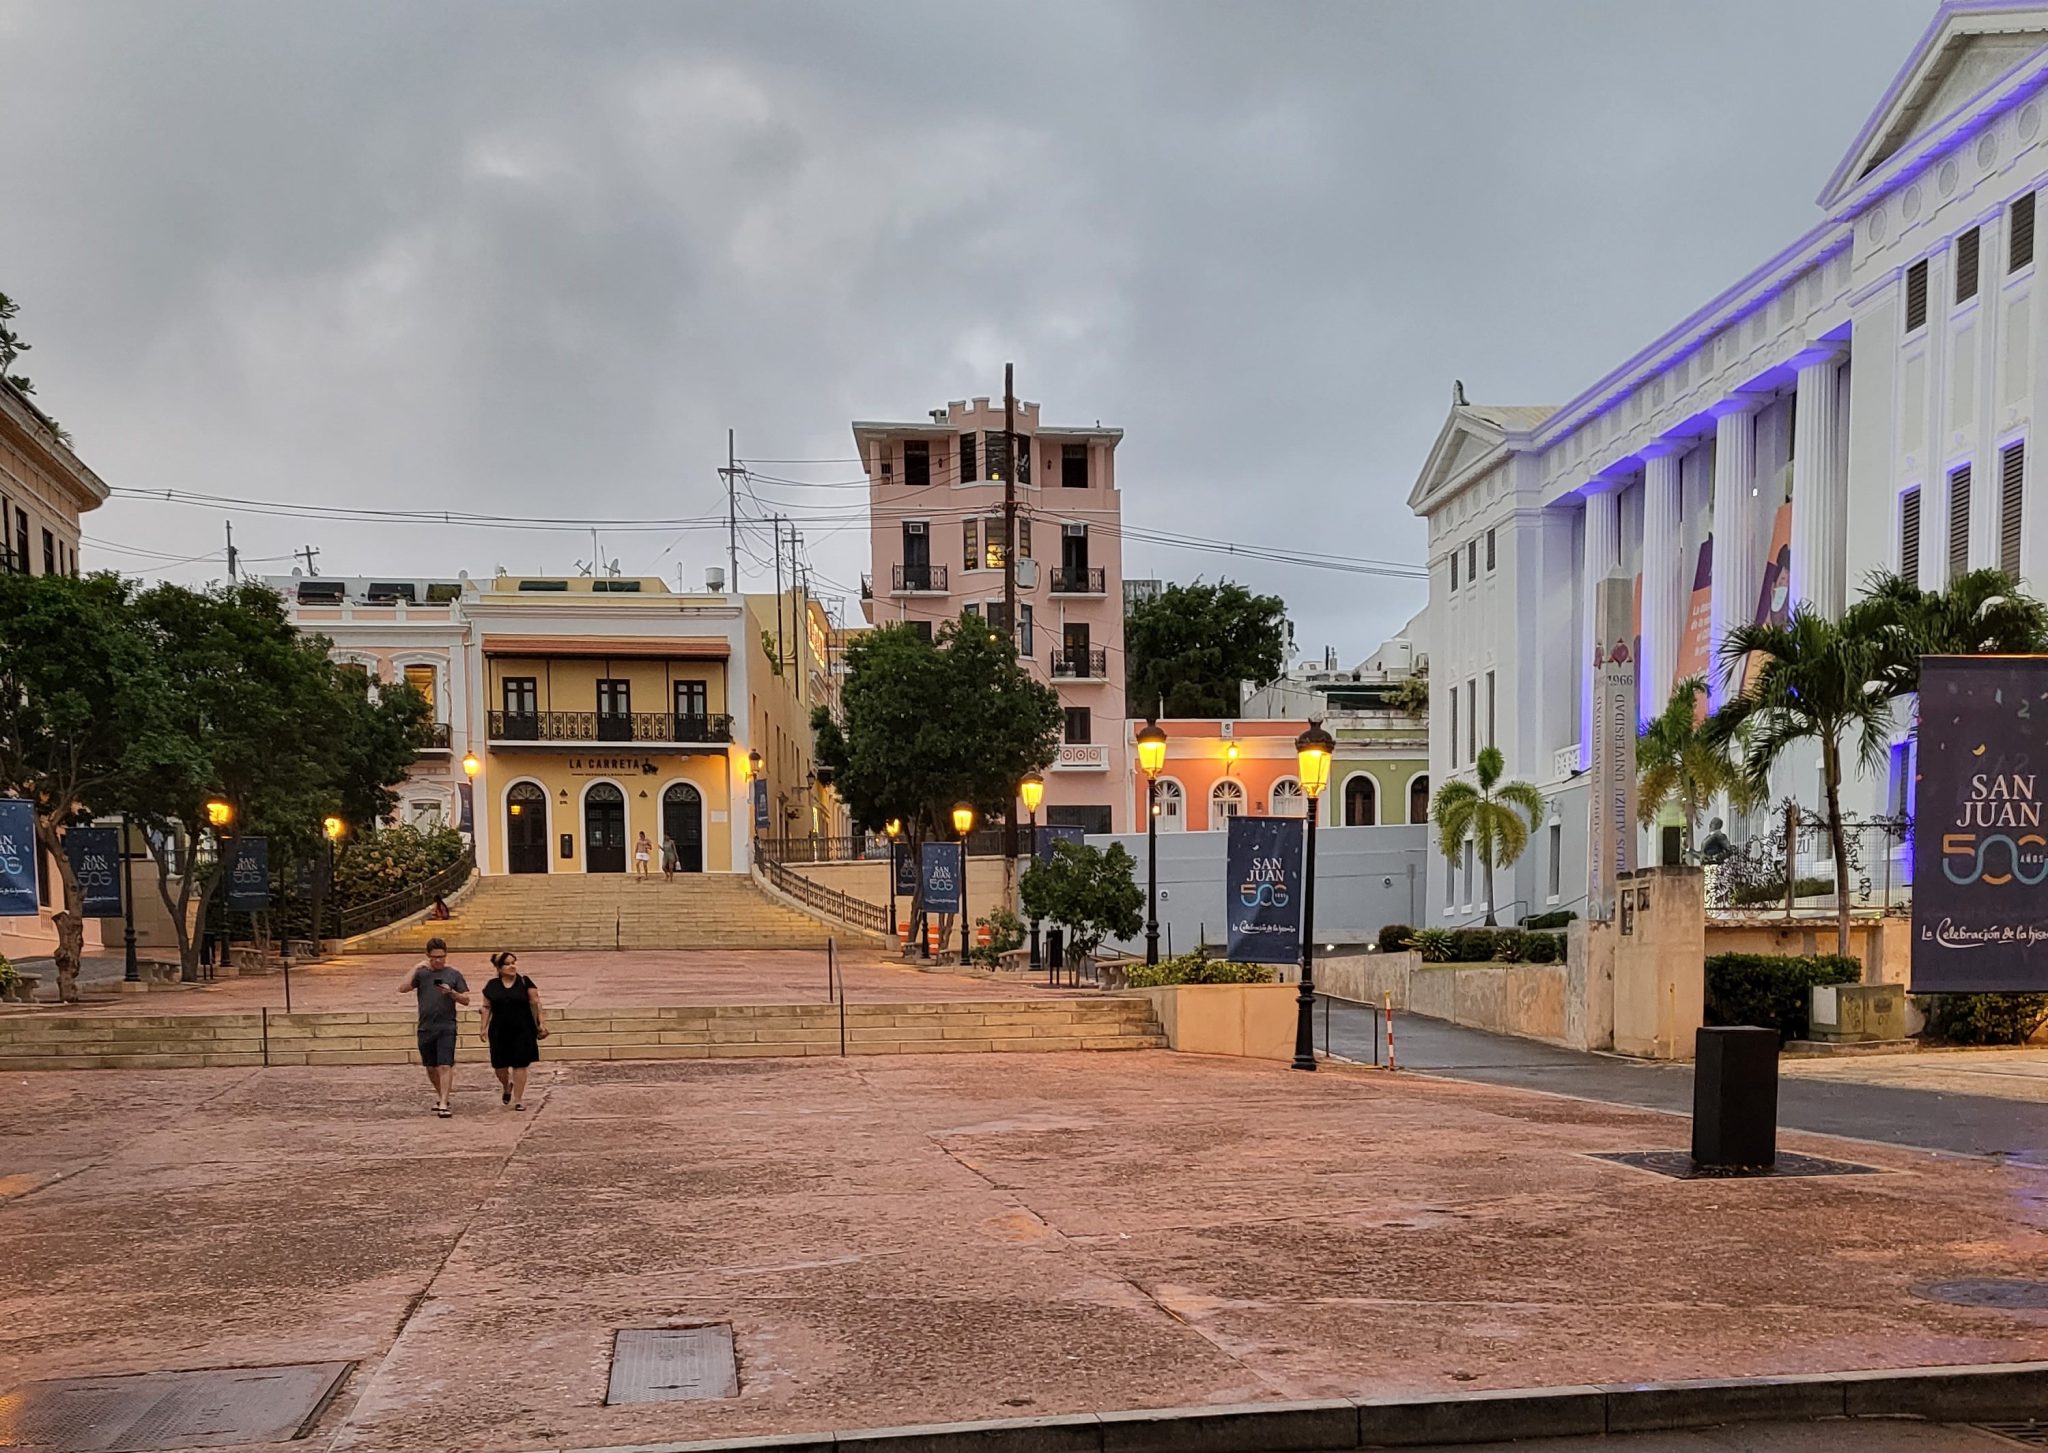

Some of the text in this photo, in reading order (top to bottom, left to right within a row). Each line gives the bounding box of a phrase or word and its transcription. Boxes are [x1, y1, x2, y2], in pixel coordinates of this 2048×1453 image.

[1607, 674, 1633, 686] 1966
[569, 759, 640, 769] LA CARRETA
[1614, 694, 1626, 870] RLOS ALBIZU UNIVERSIDAD
[1971, 774, 2036, 800] SAN
[1956, 801, 2043, 827] JUAN
[0, 844, 16, 855] AN
[84, 855, 105, 863] SAN
[1252, 857, 1282, 870] SAN
[1942, 834, 2048, 885] 500
[2020, 853, 2044, 863] AÑOS
[81, 862, 108, 870] JUAN
[235, 863, 258, 871] JUAN
[932, 871, 951, 879] JUAN
[1246, 869, 1285, 882] JUAN
[1240, 883, 1289, 907] 500
[1922, 925, 1934, 940] La
[1936, 918, 2000, 949] Celebración
[1998, 926, 2015, 944] de
[2016, 926, 2027, 940] la
